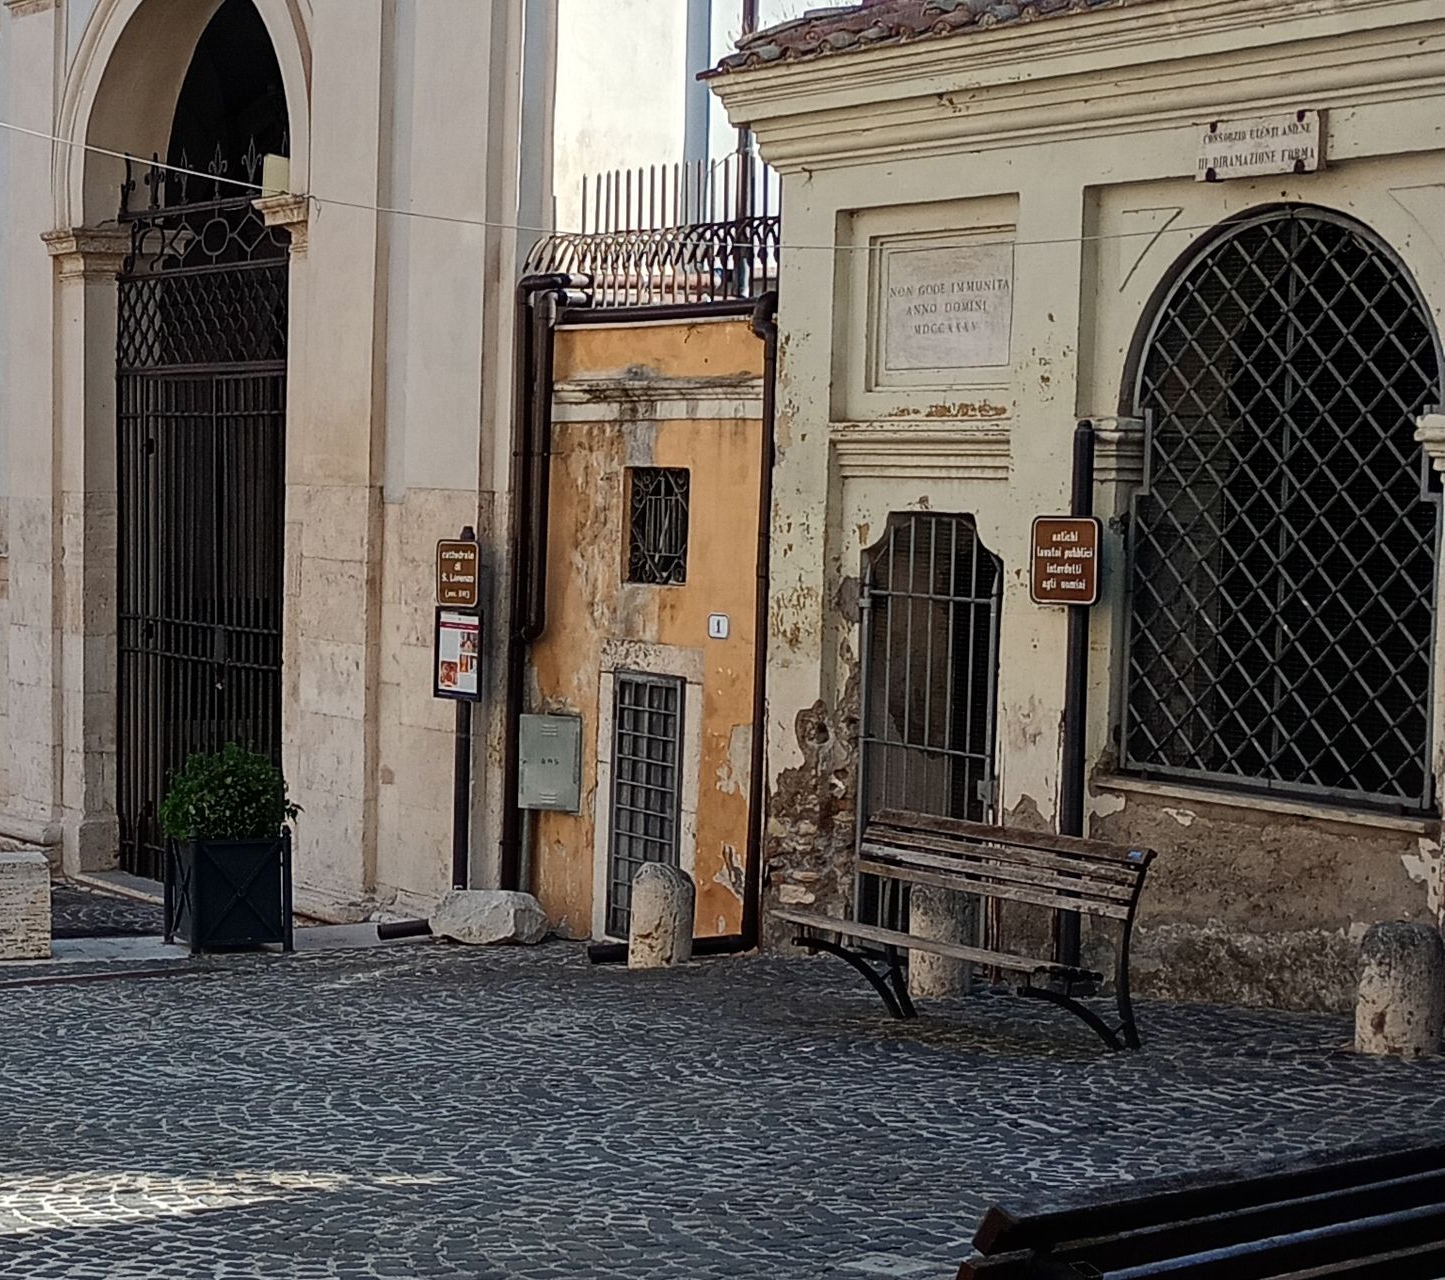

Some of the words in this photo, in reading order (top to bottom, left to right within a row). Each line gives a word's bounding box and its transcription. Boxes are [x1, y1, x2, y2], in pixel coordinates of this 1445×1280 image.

[1202, 130, 1247, 145] CONSORZIO
[1212, 149, 1277, 169] DIRAMAZIONE
[1281, 146, 1315, 163] FORMA
[889, 286, 914, 298] NON
[918, 282, 946, 296] GODE
[905, 303, 937, 316] ANNO
[944, 299, 987, 314] DOMINI
[1051, 530, 1079, 542] antichi
[1036, 545, 1062, 558] lavatoi
[1064, 546, 1093, 560] pubblici
[1046, 562, 1082, 575] interdetti
[1041, 578, 1057, 591] agli
[1060, 578, 1086, 590] uomini
